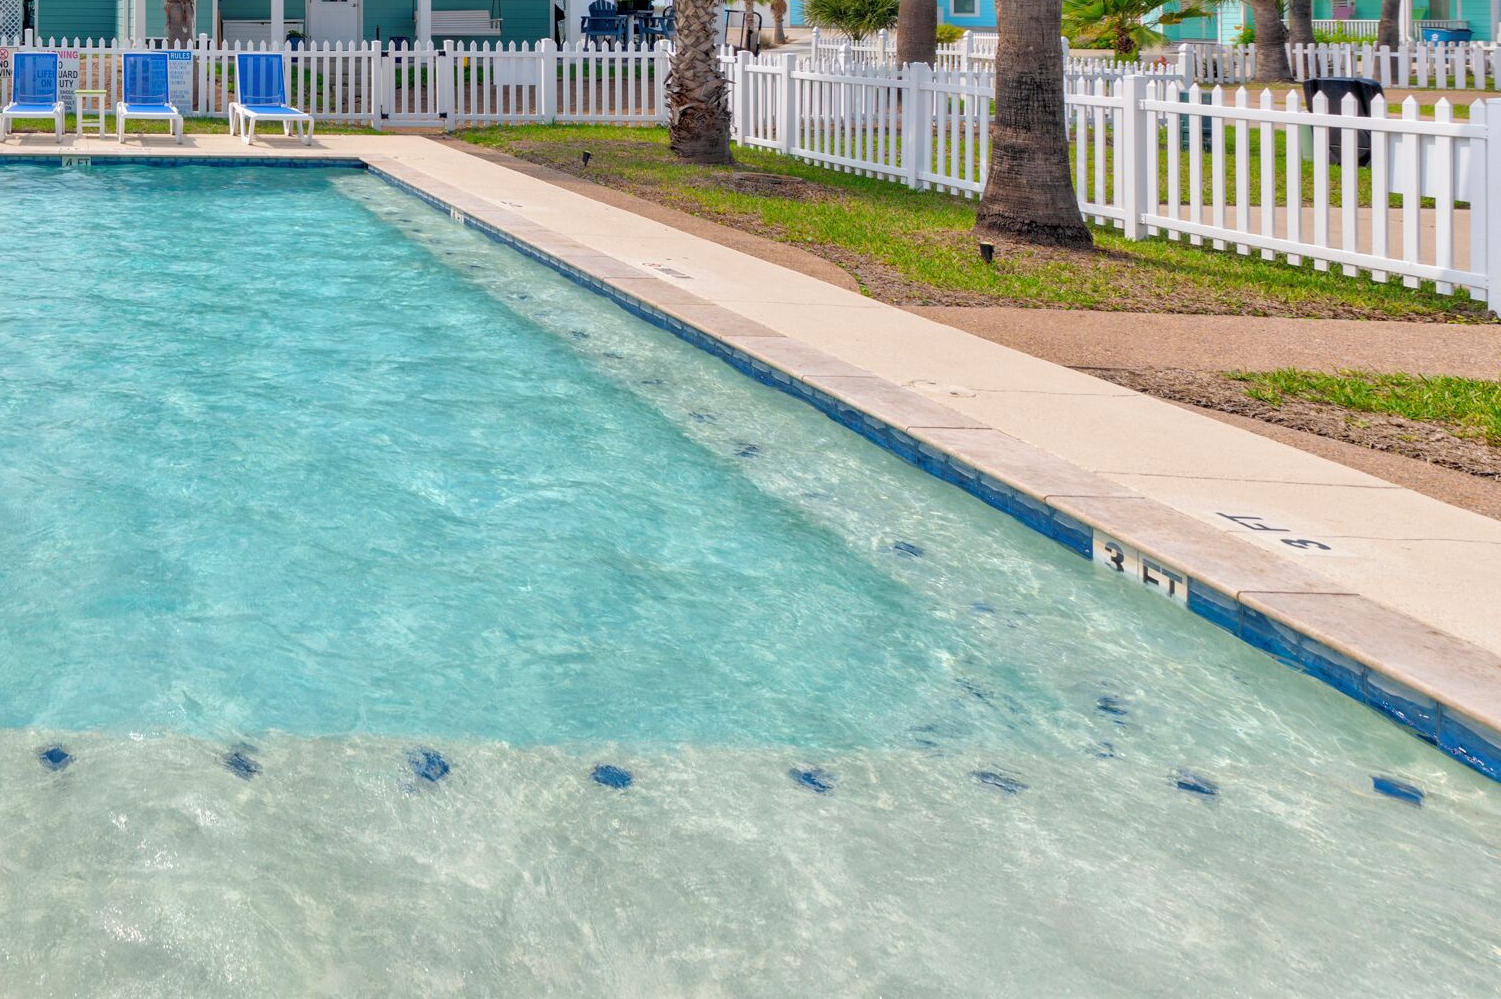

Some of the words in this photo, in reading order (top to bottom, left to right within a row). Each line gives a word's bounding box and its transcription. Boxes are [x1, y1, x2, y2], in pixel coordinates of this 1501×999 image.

[41, 80, 52, 88] ON
[59, 80, 74, 88] UTY
[1215, 512, 1291, 532] FT
[1280, 539, 1331, 550] 3
[1104, 542, 1125, 573] 3
[1143, 557, 1182, 598] FT
